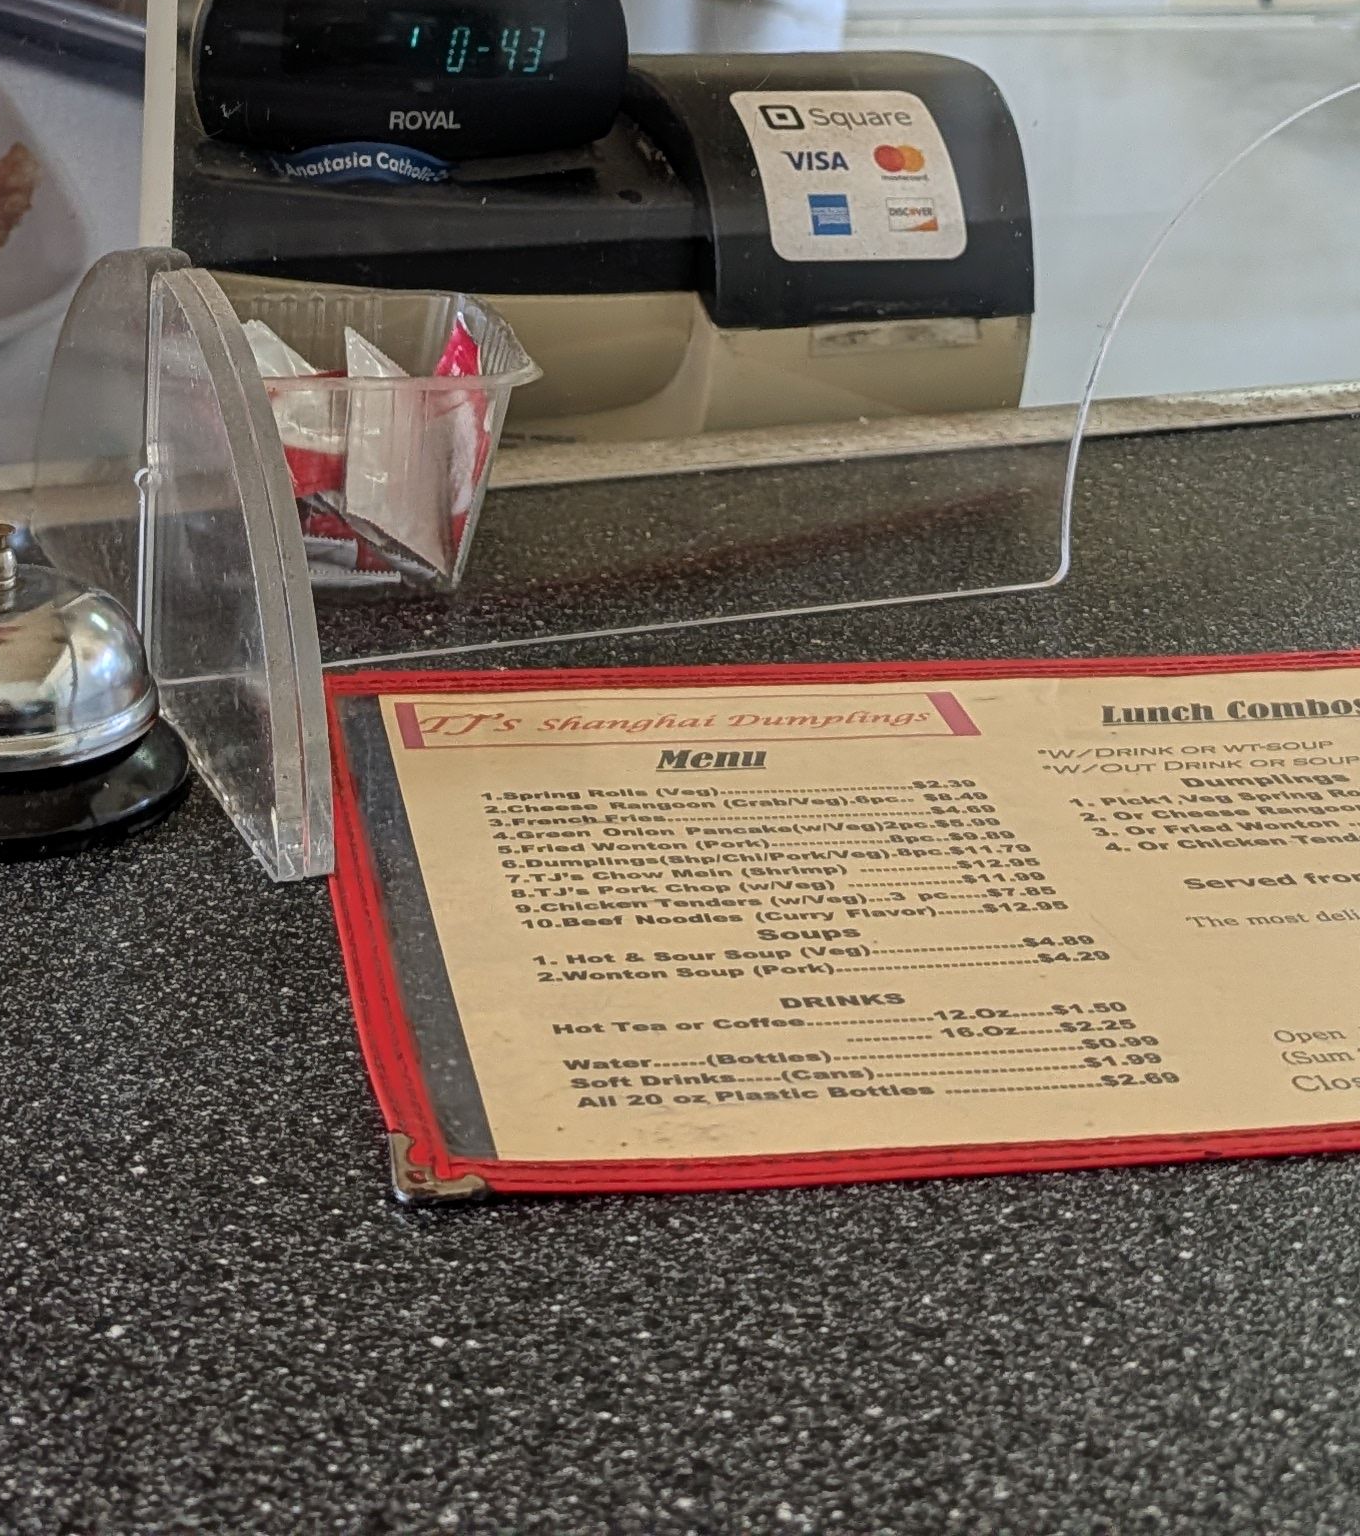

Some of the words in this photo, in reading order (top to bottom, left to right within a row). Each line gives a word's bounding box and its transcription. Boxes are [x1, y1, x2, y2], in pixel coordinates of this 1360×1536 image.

[390, 111, 462, 131] ROYAL
[808, 107, 913, 131] Square
[780, 151, 850, 172] VISA
[1101, 702, 1214, 724] Lunch
[419, 713, 523, 736] TJ's
[537, 713, 715, 734] Shanghai
[728, 709, 931, 729] Dumplings
[1181, 745, 1215, 755] OR
[656, 748, 767, 770] Menu
[1163, 759, 1243, 772] DRINK
[1249, 757, 1285, 768] OR
[1292, 755, 1360, 767] SOUP
[1180, 772, 1351, 789] Dumplings
[588, 788, 649, 798] Rolls
[1238, 789, 1324, 803] Spring
[609, 800, 716, 811] Rangoon
[605, 813, 667, 823] Fries
[1112, 811, 1144, 822] Or
[1151, 806, 1251, 819] Cheese
[602, 826, 675, 837] Onion
[1125, 824, 1157, 836] Or
[1163, 822, 1233, 835] Fried
[1240, 817, 1340, 832] Wonton
[591, 840, 687, 852] Wonton
[1138, 839, 1170, 851] Or
[1177, 836, 1288, 850] Chicken
[592, 869, 664, 881] Chow
[671, 868, 733, 879] Mein
[741, 863, 848, 878] (Shrimp)
[597, 884, 658, 895] Pork
[665, 882, 732, 894] Chop
[1183, 871, 1297, 892] Served
[653, 896, 762, 909] Tenders
[635, 913, 744, 925] Noodles
[755, 910, 835, 924] (Curry
[1247, 911, 1310, 926] most
[756, 927, 862, 942] Soups
[566, 952, 617, 964] Hot
[653, 950, 716, 962] Sour
[724, 948, 792, 961] Soup
[676, 966, 745, 979] Soup
[779, 993, 906, 1010] DRINKS
[552, 1022, 605, 1035] Hot
[611, 1021, 667, 1033] Tea
[674, 1020, 705, 1031] or
[712, 1016, 806, 1030] Coffee
[1273, 1028, 1347, 1044] Open
[563, 1056, 653, 1071] Water
[1281, 1050, 1354, 1066] (Sum
[570, 1075, 633, 1089] Soft
[640, 1072, 737, 1087] Drinks
[577, 1095, 618, 1108] All
[626, 1093, 664, 1106] 20
[672, 1094, 708, 1105] oz
[715, 1087, 820, 1103] Plastic
[827, 1084, 935, 1098] Bottles
